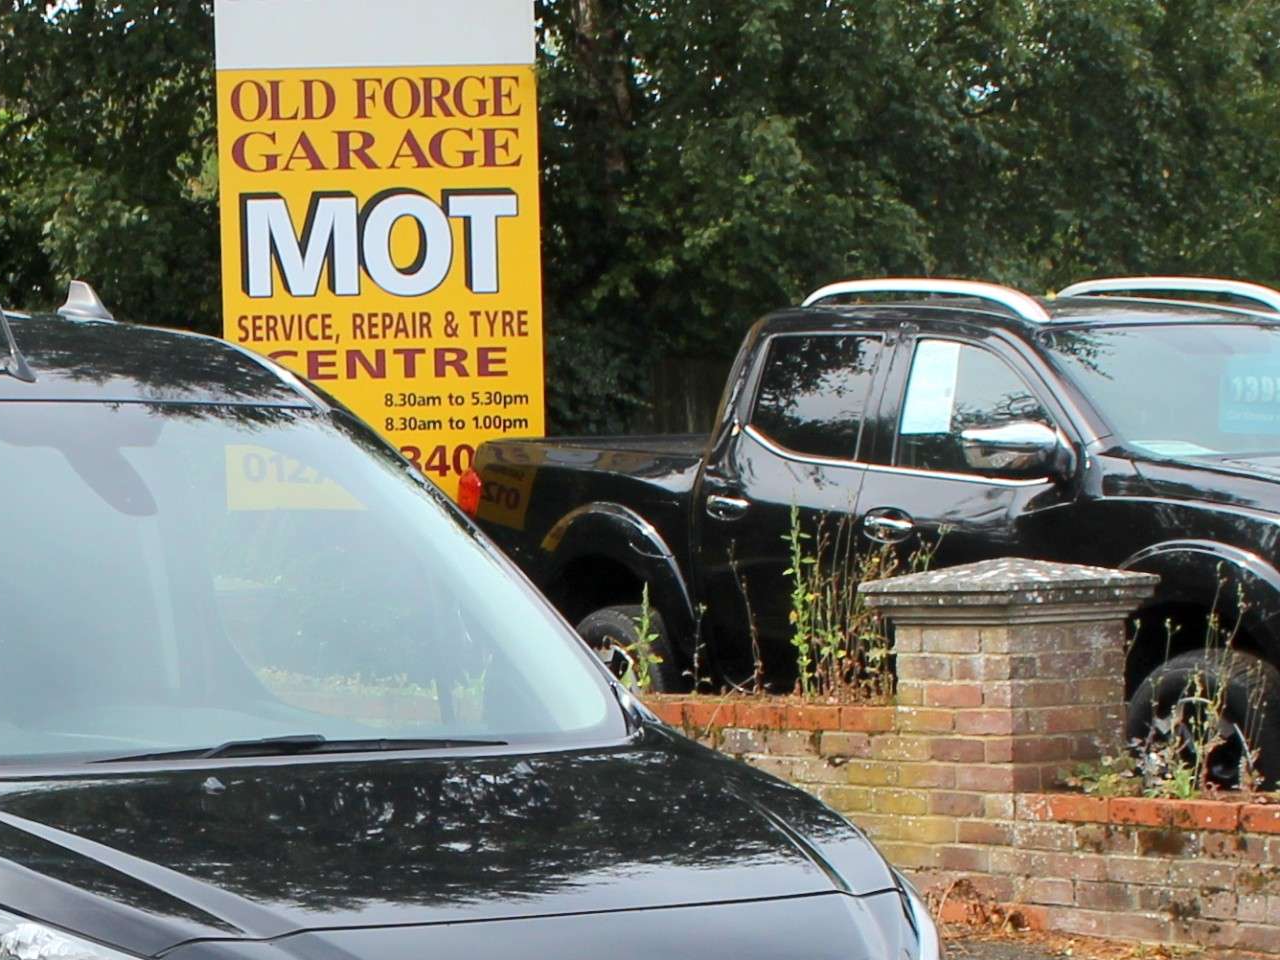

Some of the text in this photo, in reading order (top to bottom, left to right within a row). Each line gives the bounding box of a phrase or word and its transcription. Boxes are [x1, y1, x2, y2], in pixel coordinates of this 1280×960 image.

[230, 75, 522, 122] OLD FORGE
[231, 127, 523, 173] GARAGE
[239, 187, 519, 298] MOT
[237, 310, 529, 344] SERVICE, REPAIR & TYRE
[384, 391, 529, 410] 8.30am to 5.30pm
[385, 415, 529, 434] 8.30am to 1.00pm
